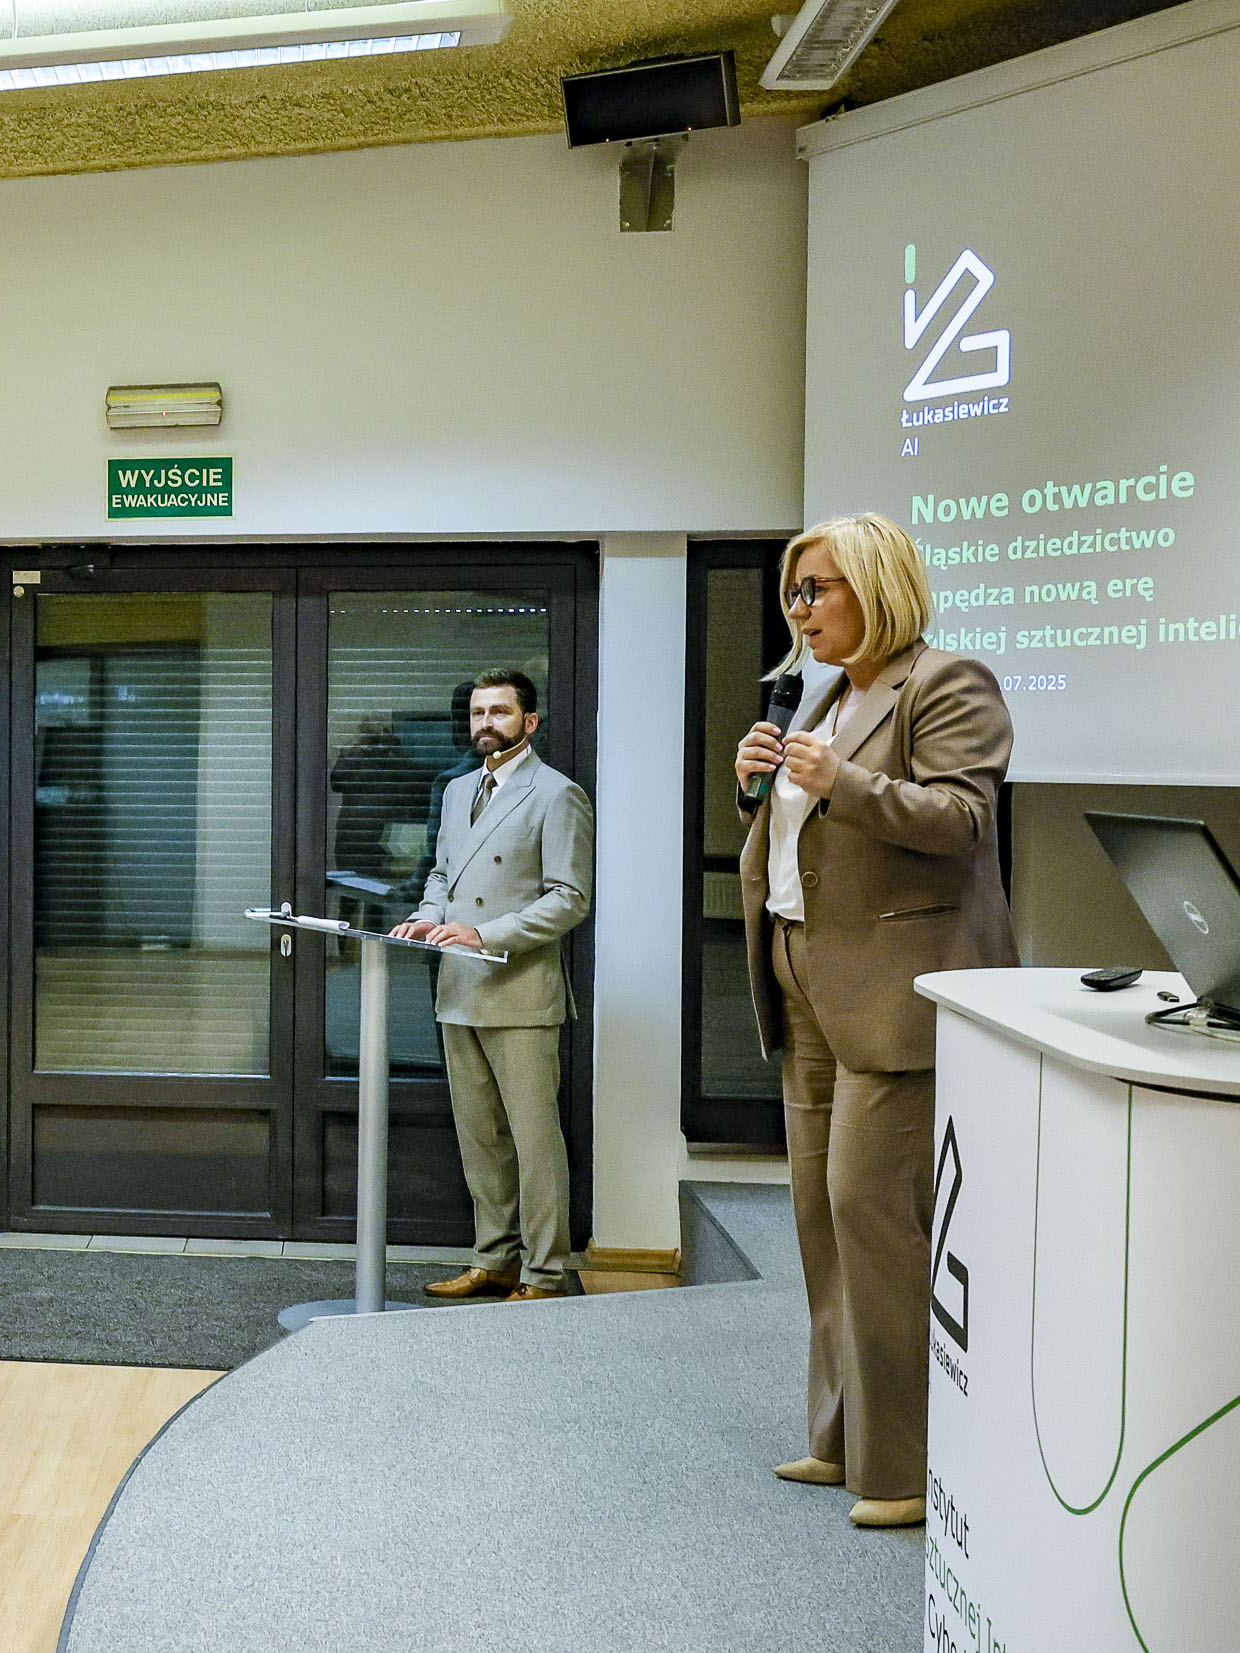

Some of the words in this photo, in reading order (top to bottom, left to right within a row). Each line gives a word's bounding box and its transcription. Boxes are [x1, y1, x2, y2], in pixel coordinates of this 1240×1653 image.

[900, 396, 1009, 428] Łukasiewicz
[901, 437, 919, 457] AI
[118, 464, 223, 488] WYJŚCIE
[112, 493, 229, 508] EWAKUACYJNE
[911, 492, 1009, 525] Nowe
[1021, 465, 1195, 514] otwarcie
[1007, 527, 1175, 560] dziedzictwo
[931, 583, 1014, 613] pędza
[1024, 579, 1100, 605] nową
[1106, 576, 1155, 601] erę
[923, 626, 1007, 655] lskiej
[1015, 618, 1147, 650] sztucznej
[1158, 613, 1240, 643] inteli
[1000, 674, 1067, 692] 07.2025
[931, 1329, 968, 1397] asiewicz
[927, 1467, 969, 1559] nstytut
